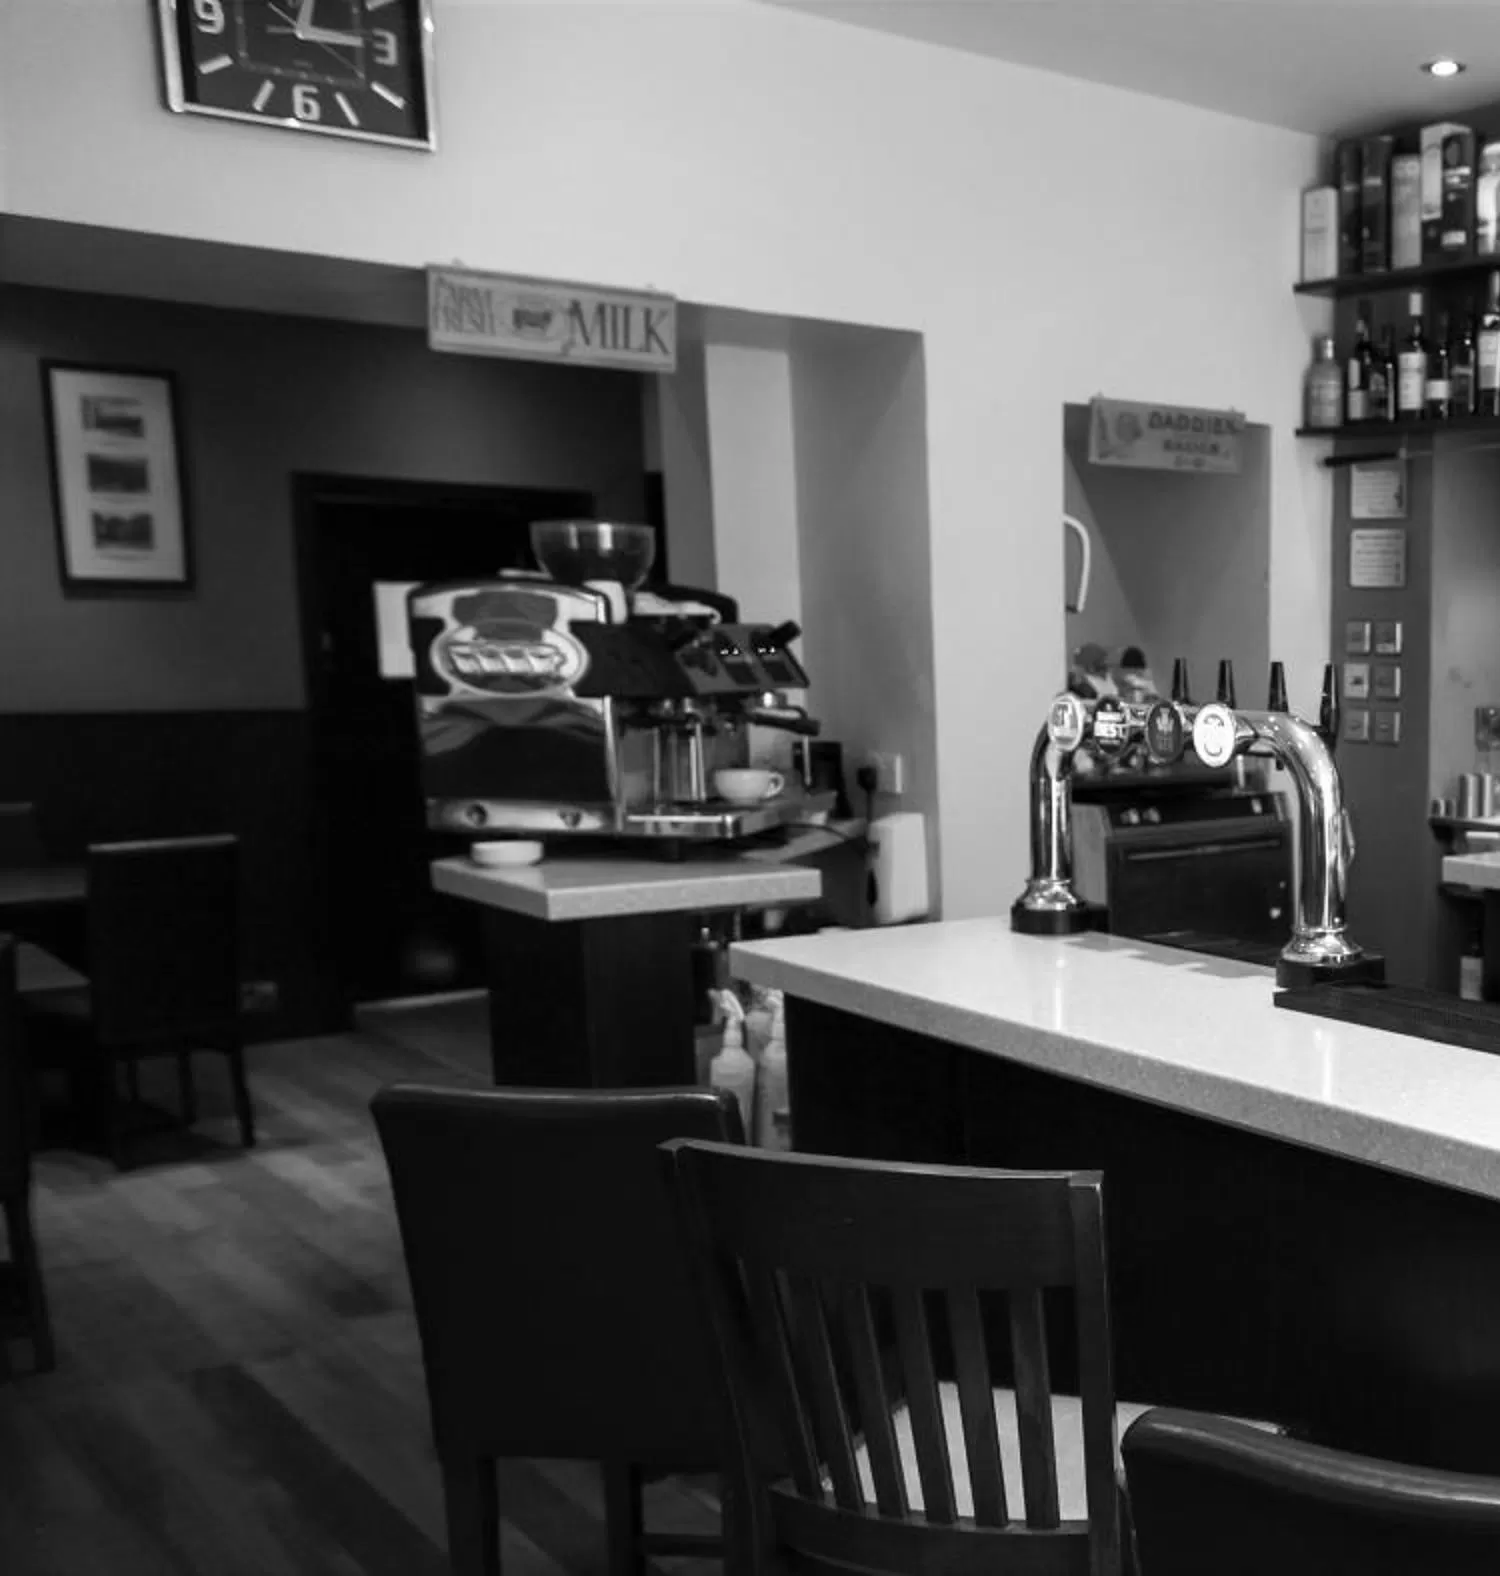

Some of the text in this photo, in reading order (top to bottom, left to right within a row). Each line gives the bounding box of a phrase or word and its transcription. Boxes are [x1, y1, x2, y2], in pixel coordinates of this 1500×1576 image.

[194, 0, 225, 35] 9
[371, 28, 399, 67] 3
[292, 84, 321, 121] 6
[561, 299, 671, 355] MILK
